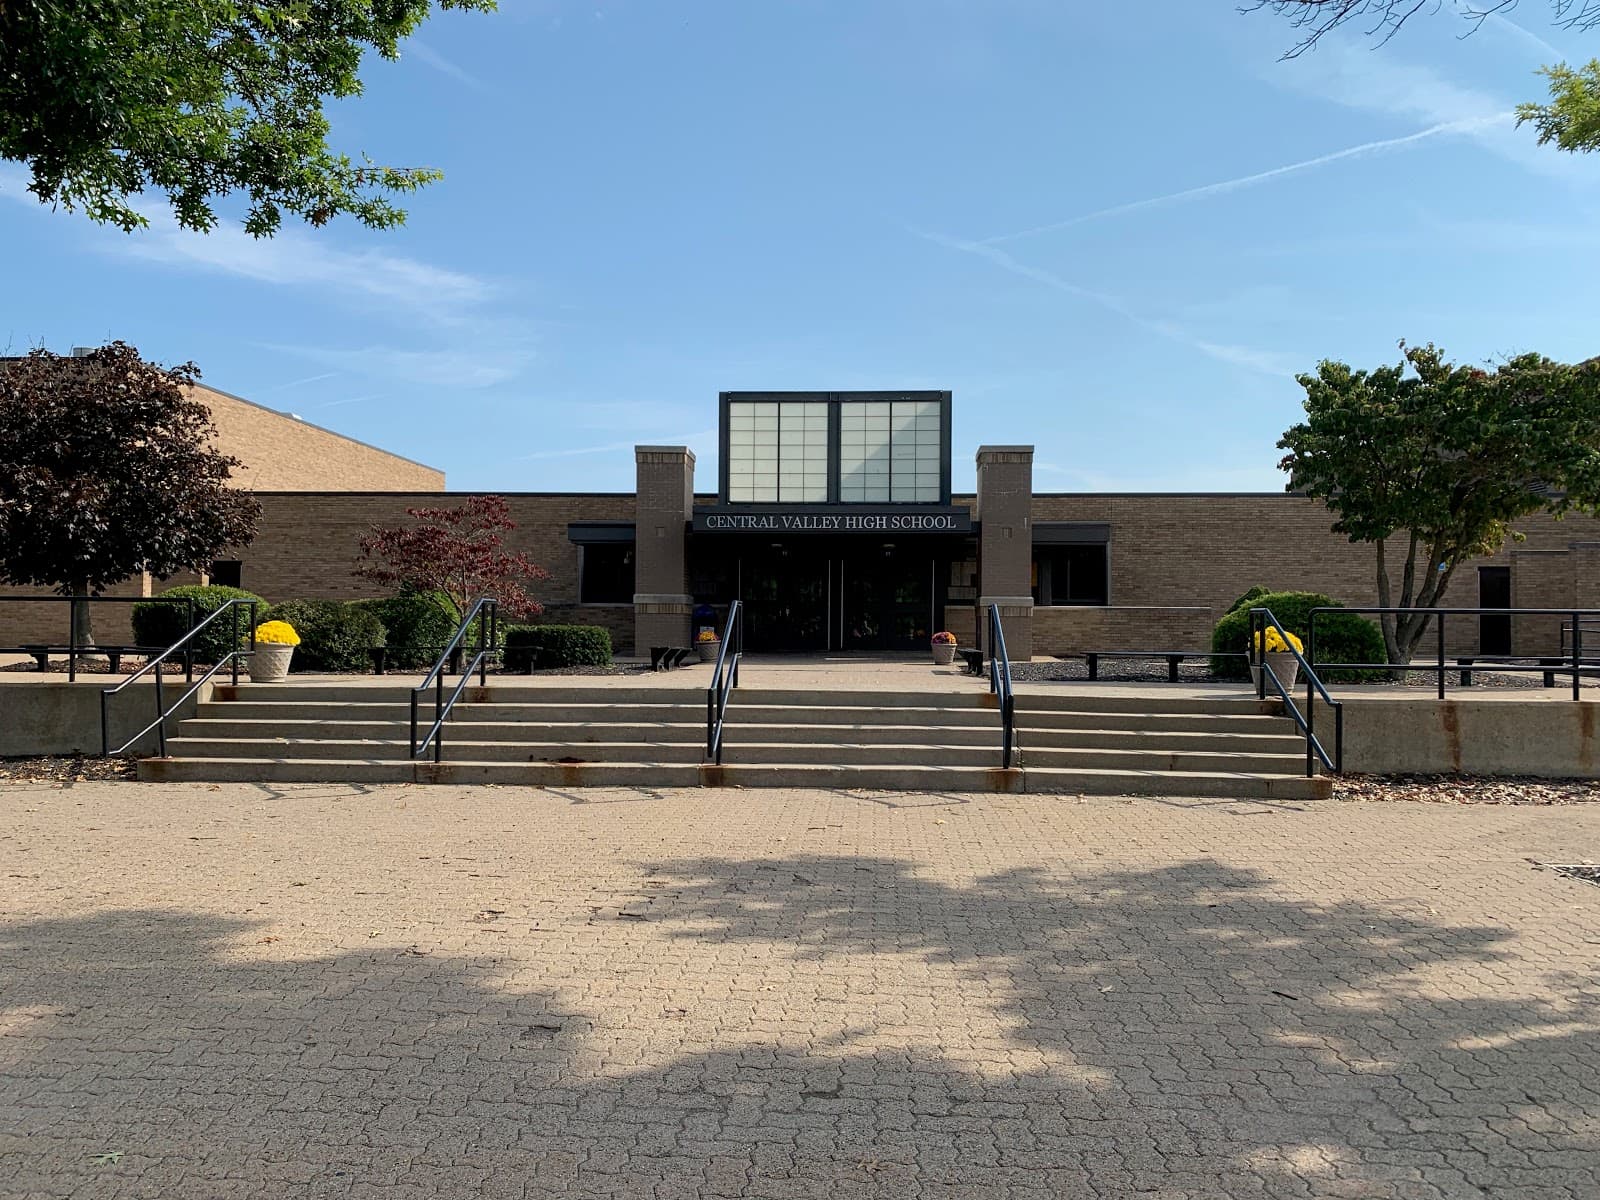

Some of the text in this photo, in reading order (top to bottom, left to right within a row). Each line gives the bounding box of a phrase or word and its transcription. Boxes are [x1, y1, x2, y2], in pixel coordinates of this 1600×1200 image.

[706, 515, 957, 529] CENTRAL VALLEY HIGH SCHOOL
